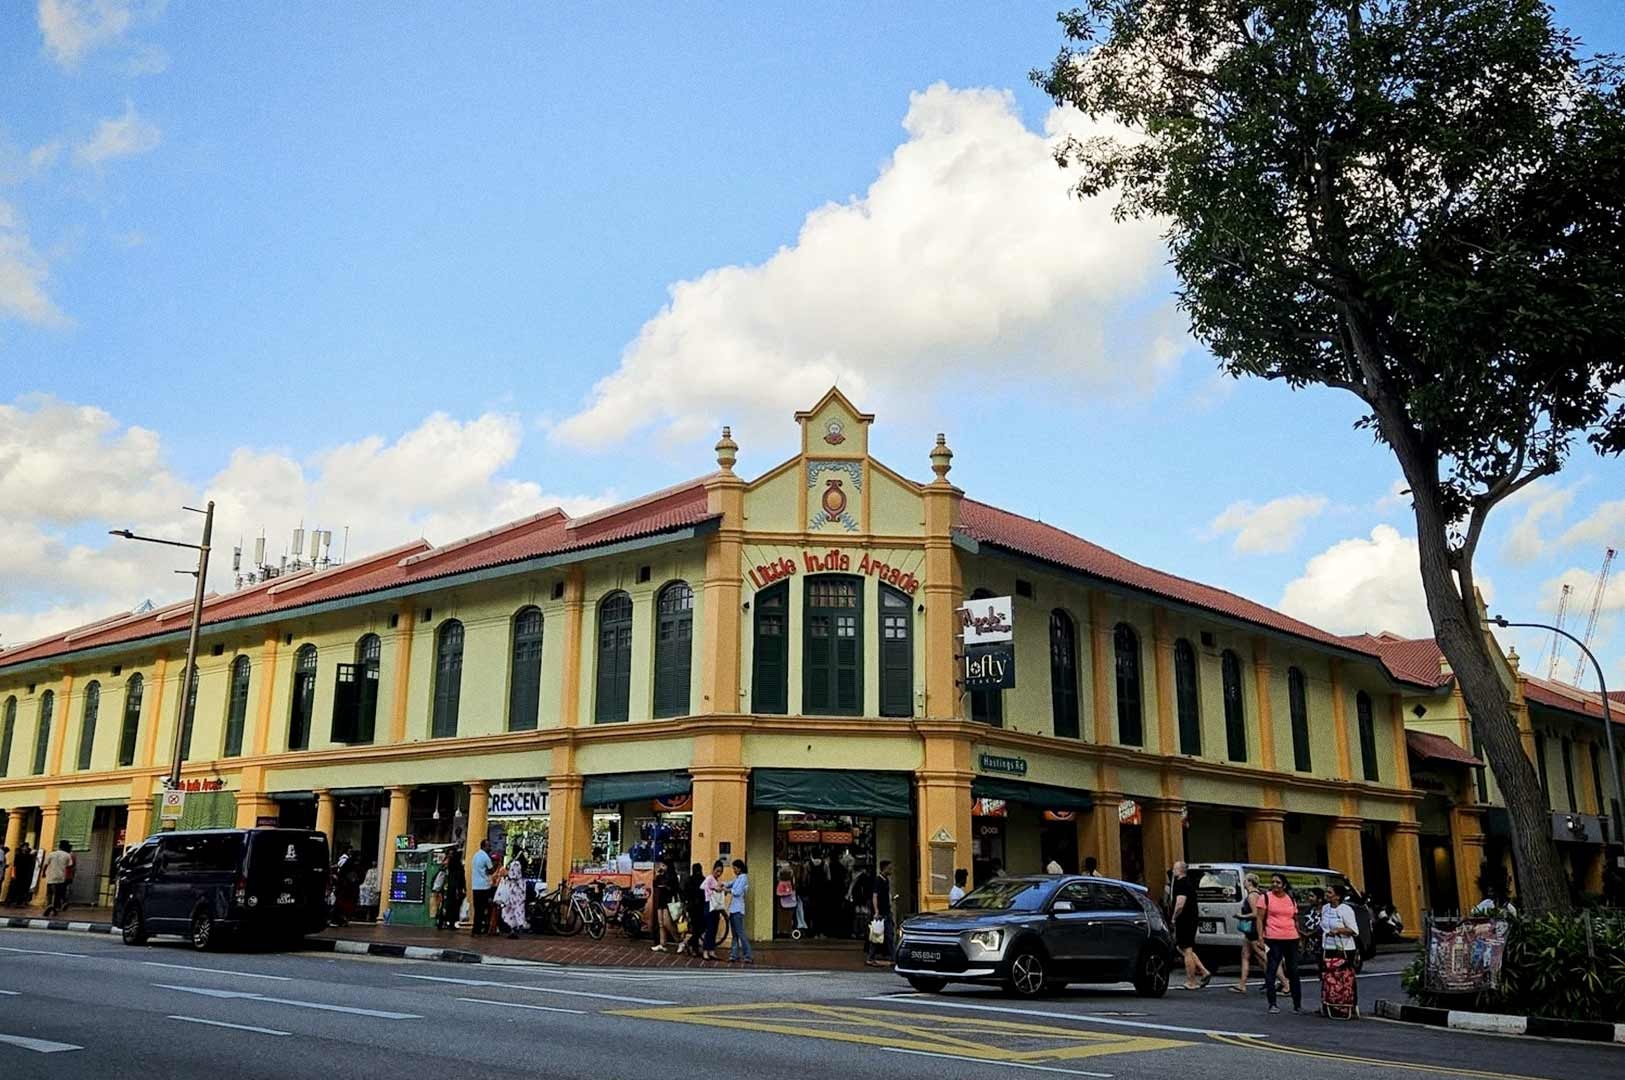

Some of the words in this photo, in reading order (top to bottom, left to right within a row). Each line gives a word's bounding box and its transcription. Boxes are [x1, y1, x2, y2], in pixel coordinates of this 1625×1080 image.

[749, 557, 797, 589] Little
[803, 549, 850, 573] India
[857, 552, 920, 595] Arcade
[965, 654, 1007, 683] Lofty
[983, 756, 1014, 771] Hastings
[1015, 760, 1024, 771] Rd
